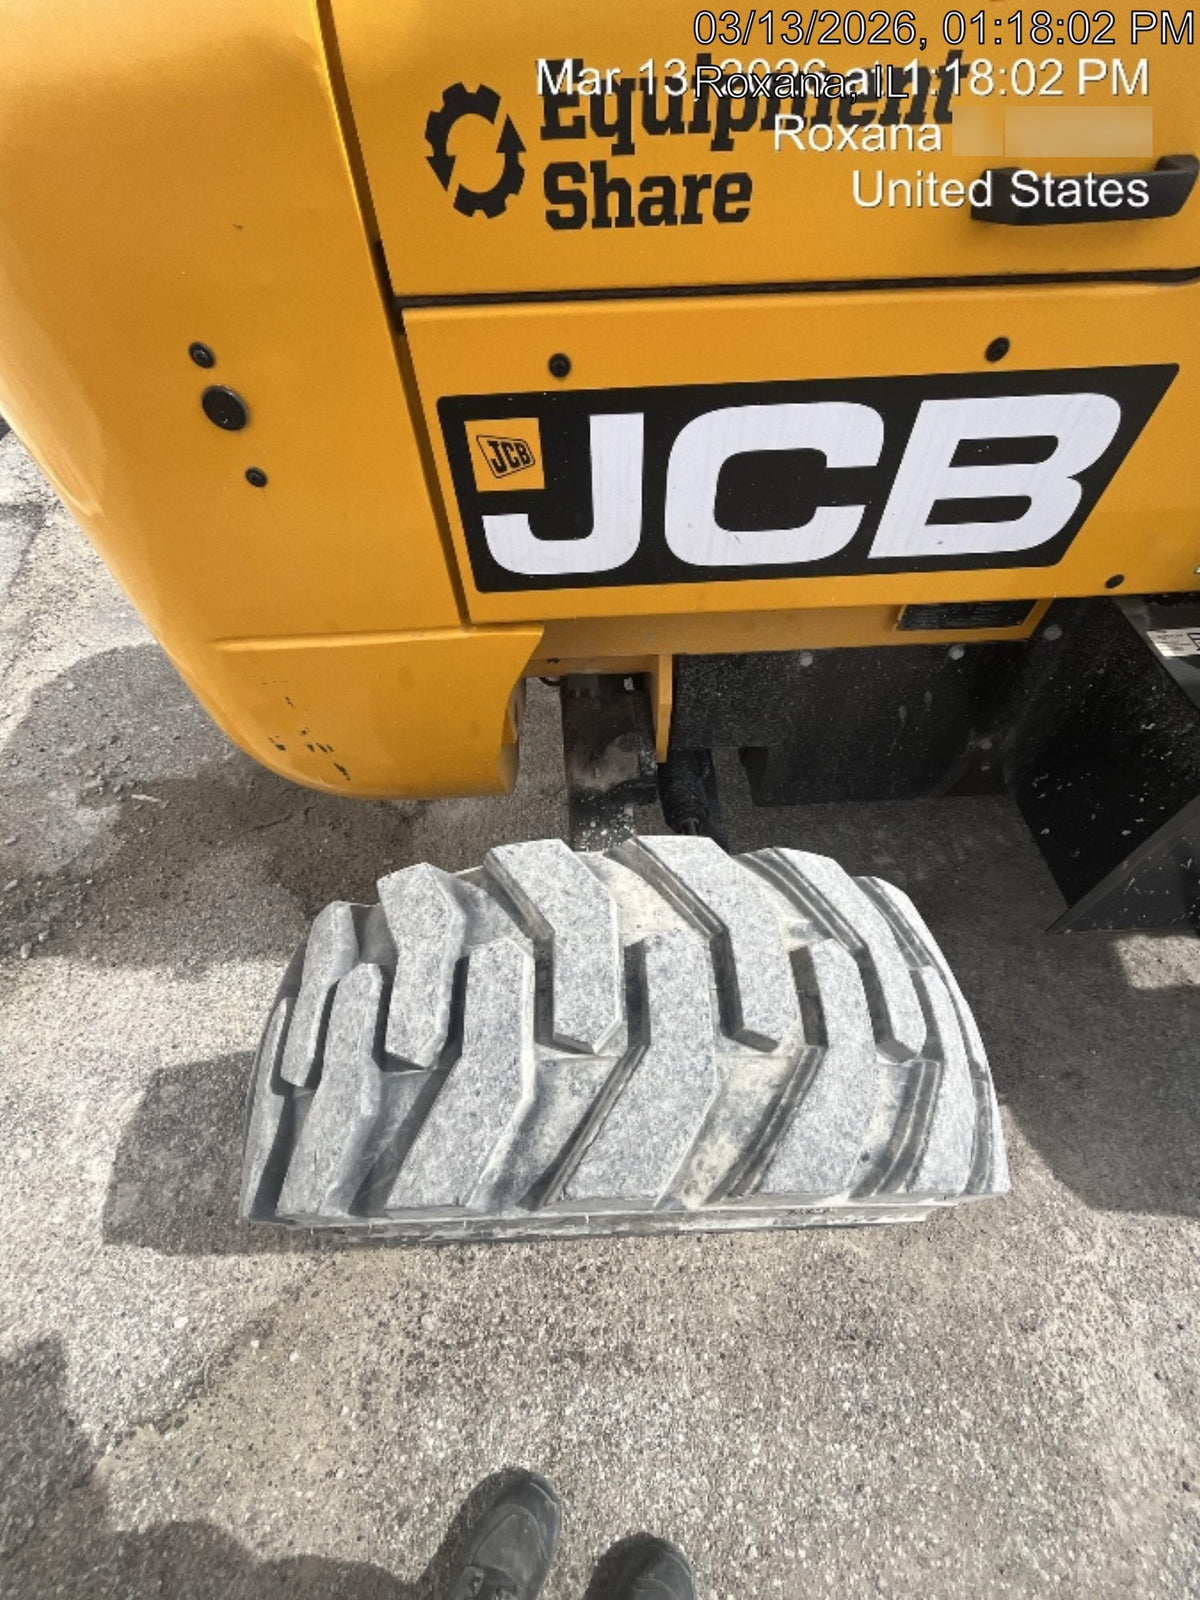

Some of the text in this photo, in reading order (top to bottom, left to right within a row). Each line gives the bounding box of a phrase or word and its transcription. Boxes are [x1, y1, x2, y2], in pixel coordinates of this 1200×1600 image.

[534, 50, 972, 156] Equipment
[543, 162, 753, 231] Share
[481, 392, 1122, 575] JCB
[487, 440, 531, 473] JCB
